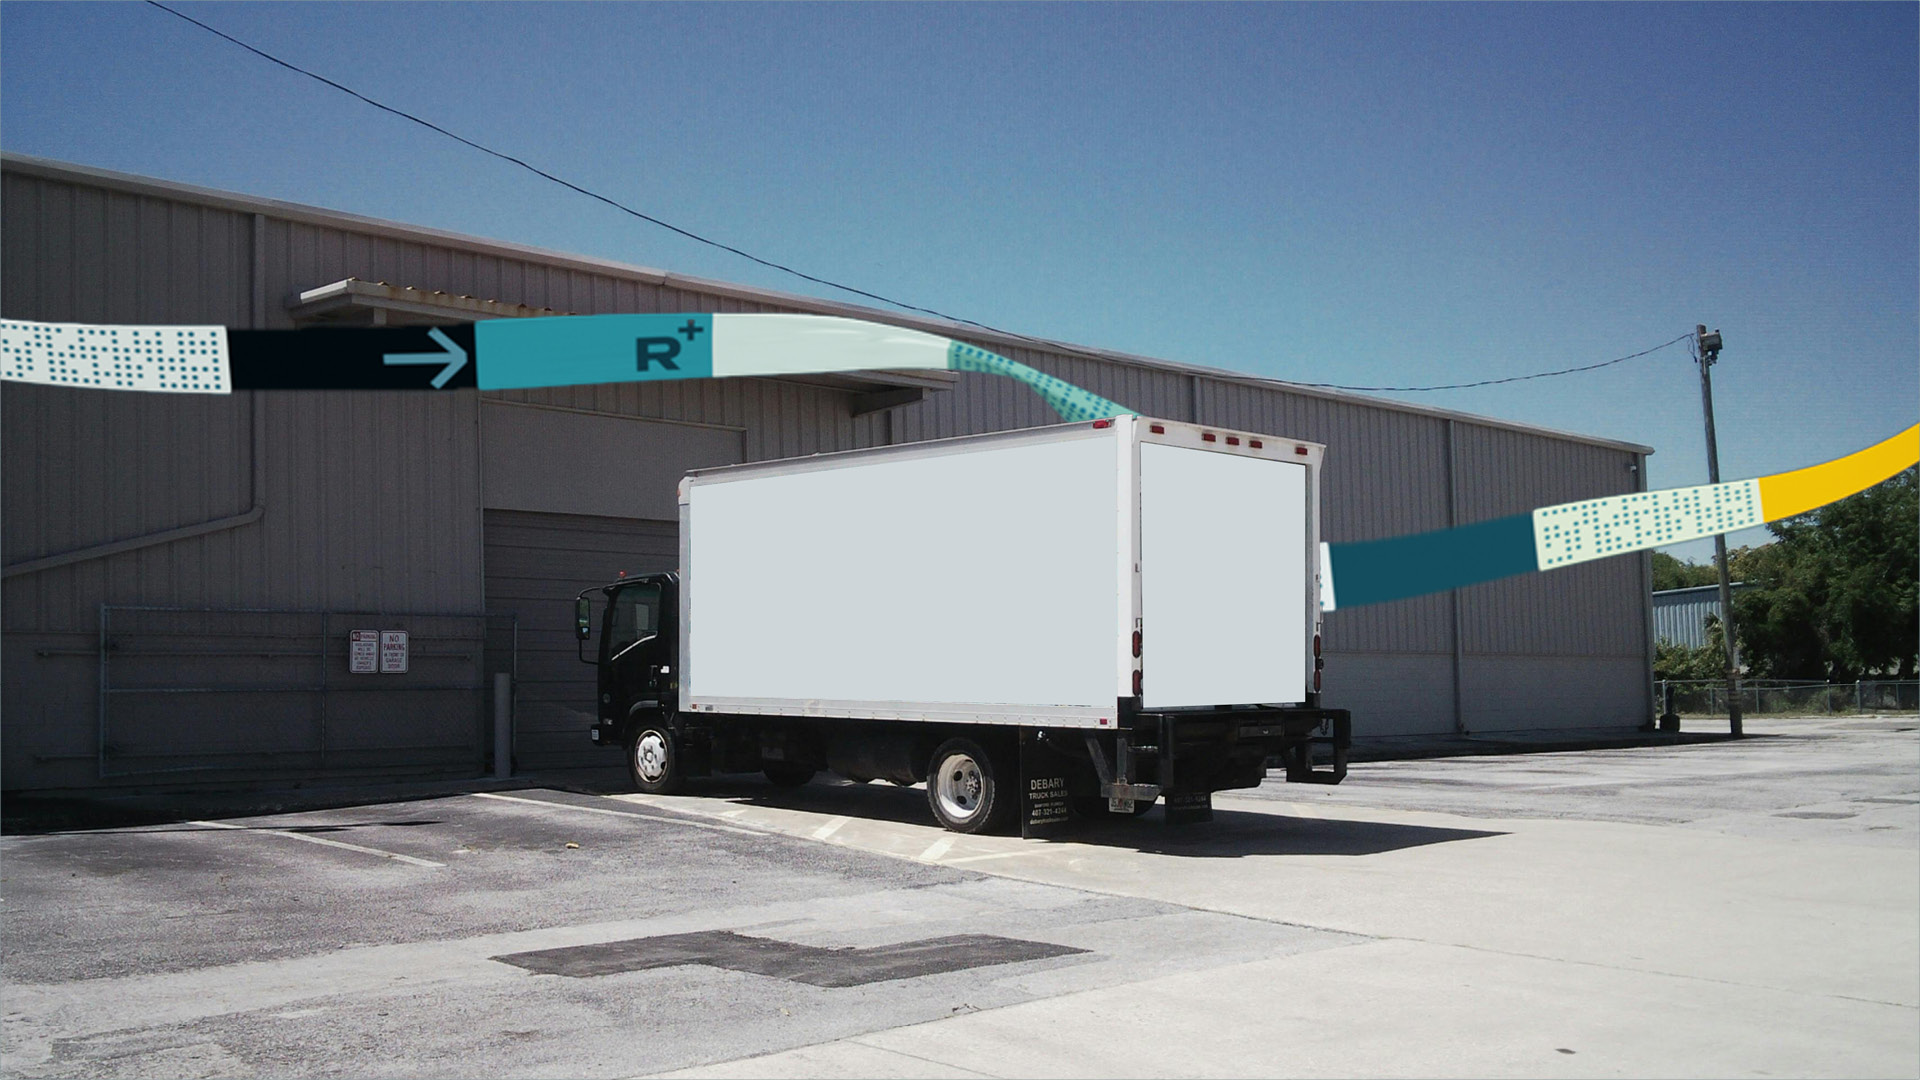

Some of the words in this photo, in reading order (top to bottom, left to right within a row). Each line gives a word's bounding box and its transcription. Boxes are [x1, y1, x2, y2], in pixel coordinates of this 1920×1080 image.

[389, 634, 400, 642] NO
[384, 643, 405, 651] PARKING
[1030, 777, 1065, 790] DEBARY
[1029, 791, 1049, 800] TRUCK
[1049, 790, 1068, 798] SALES
